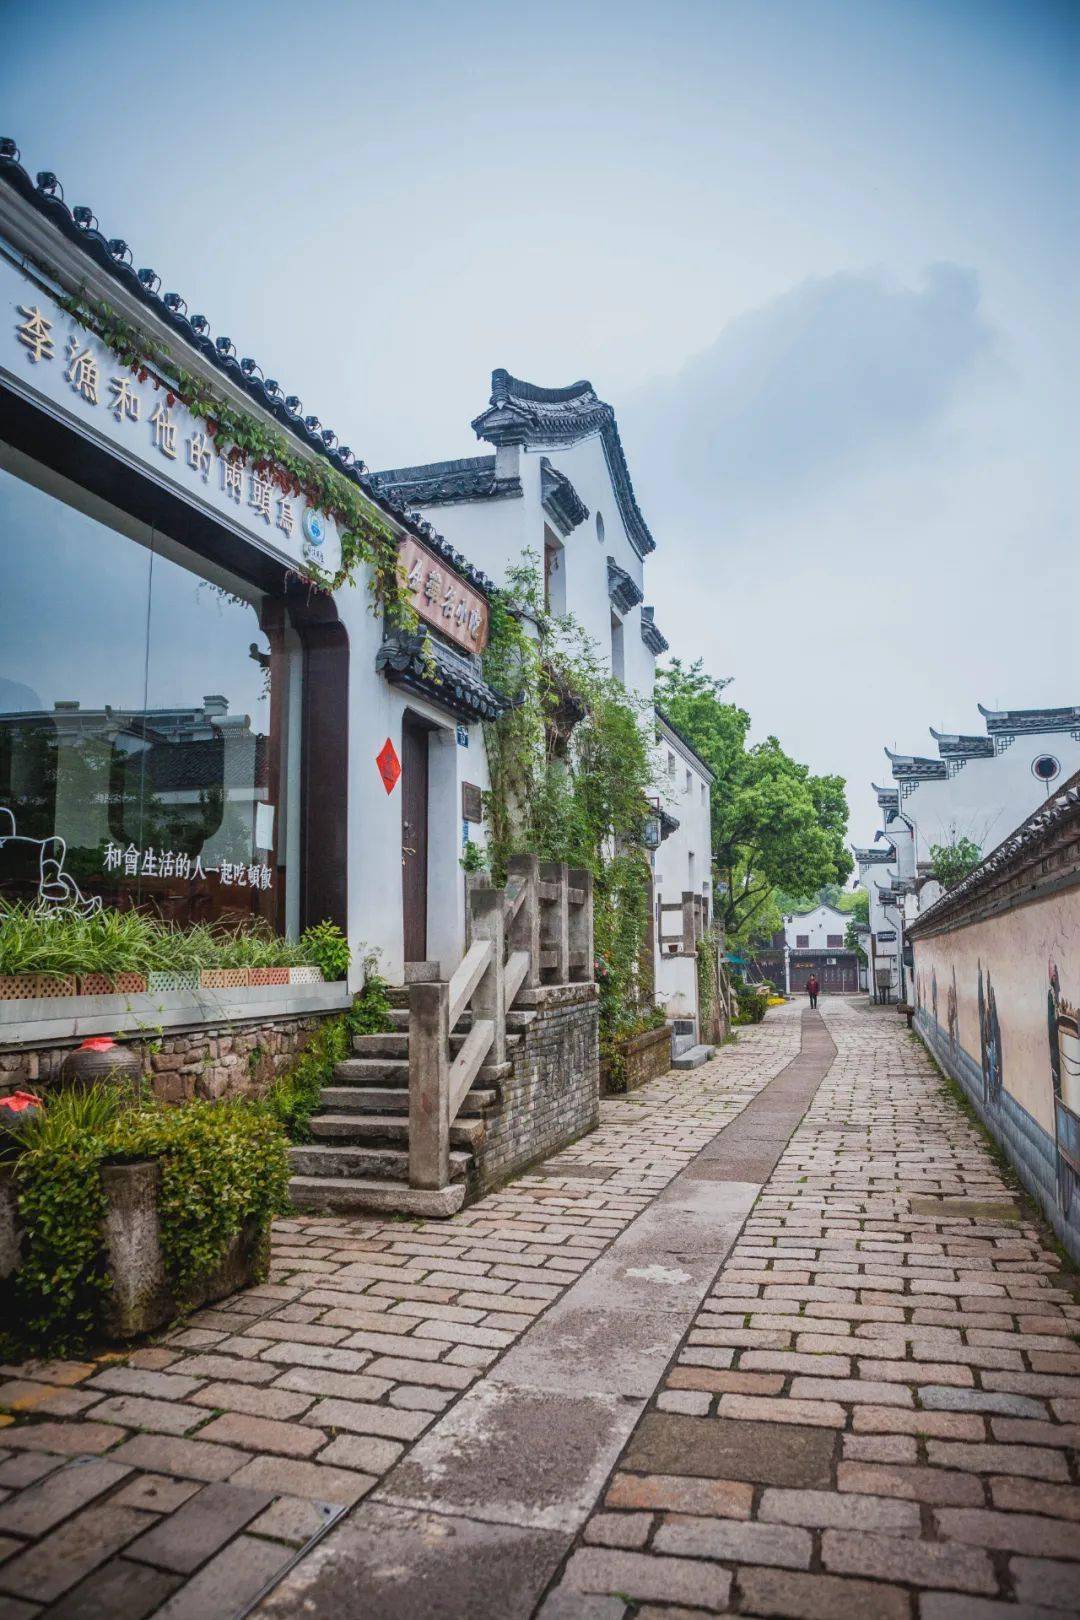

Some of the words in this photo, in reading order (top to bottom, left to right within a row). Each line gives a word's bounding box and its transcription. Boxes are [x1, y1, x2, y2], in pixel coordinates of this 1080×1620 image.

[103, 842, 273, 891] 和會生活的人一起吃頓飯
